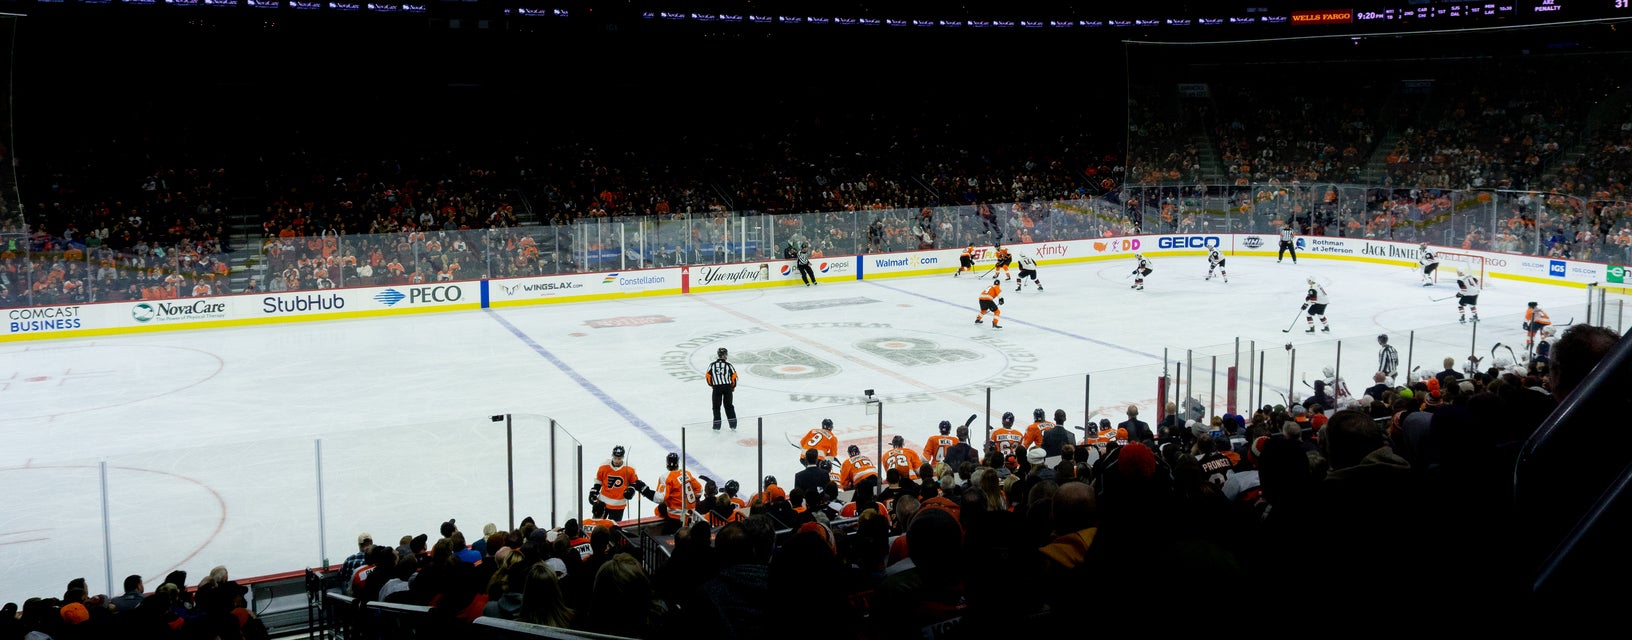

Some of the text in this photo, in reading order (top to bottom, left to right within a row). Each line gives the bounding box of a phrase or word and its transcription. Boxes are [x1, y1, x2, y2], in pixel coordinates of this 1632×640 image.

[1158, 236, 1221, 249] GEICO
[1312, 239, 1344, 247] Rothman
[1036, 244, 1068, 257] xfinity
[1320, 246, 1354, 254] Jefferson
[1361, 242, 1420, 260] JACK DANIEL
[830, 260, 849, 269] pepsi
[875, 257, 909, 267] Walmart
[1551, 264, 1565, 273] IGS
[619, 275, 665, 287] Constellation
[698, 265, 761, 286] Yuengling
[409, 285, 462, 303] PECO
[156, 300, 225, 317] NovaCare
[263, 294, 345, 314] StubHub
[9, 306, 80, 320] COMCAST
[10, 319, 81, 333] BUSINESS
